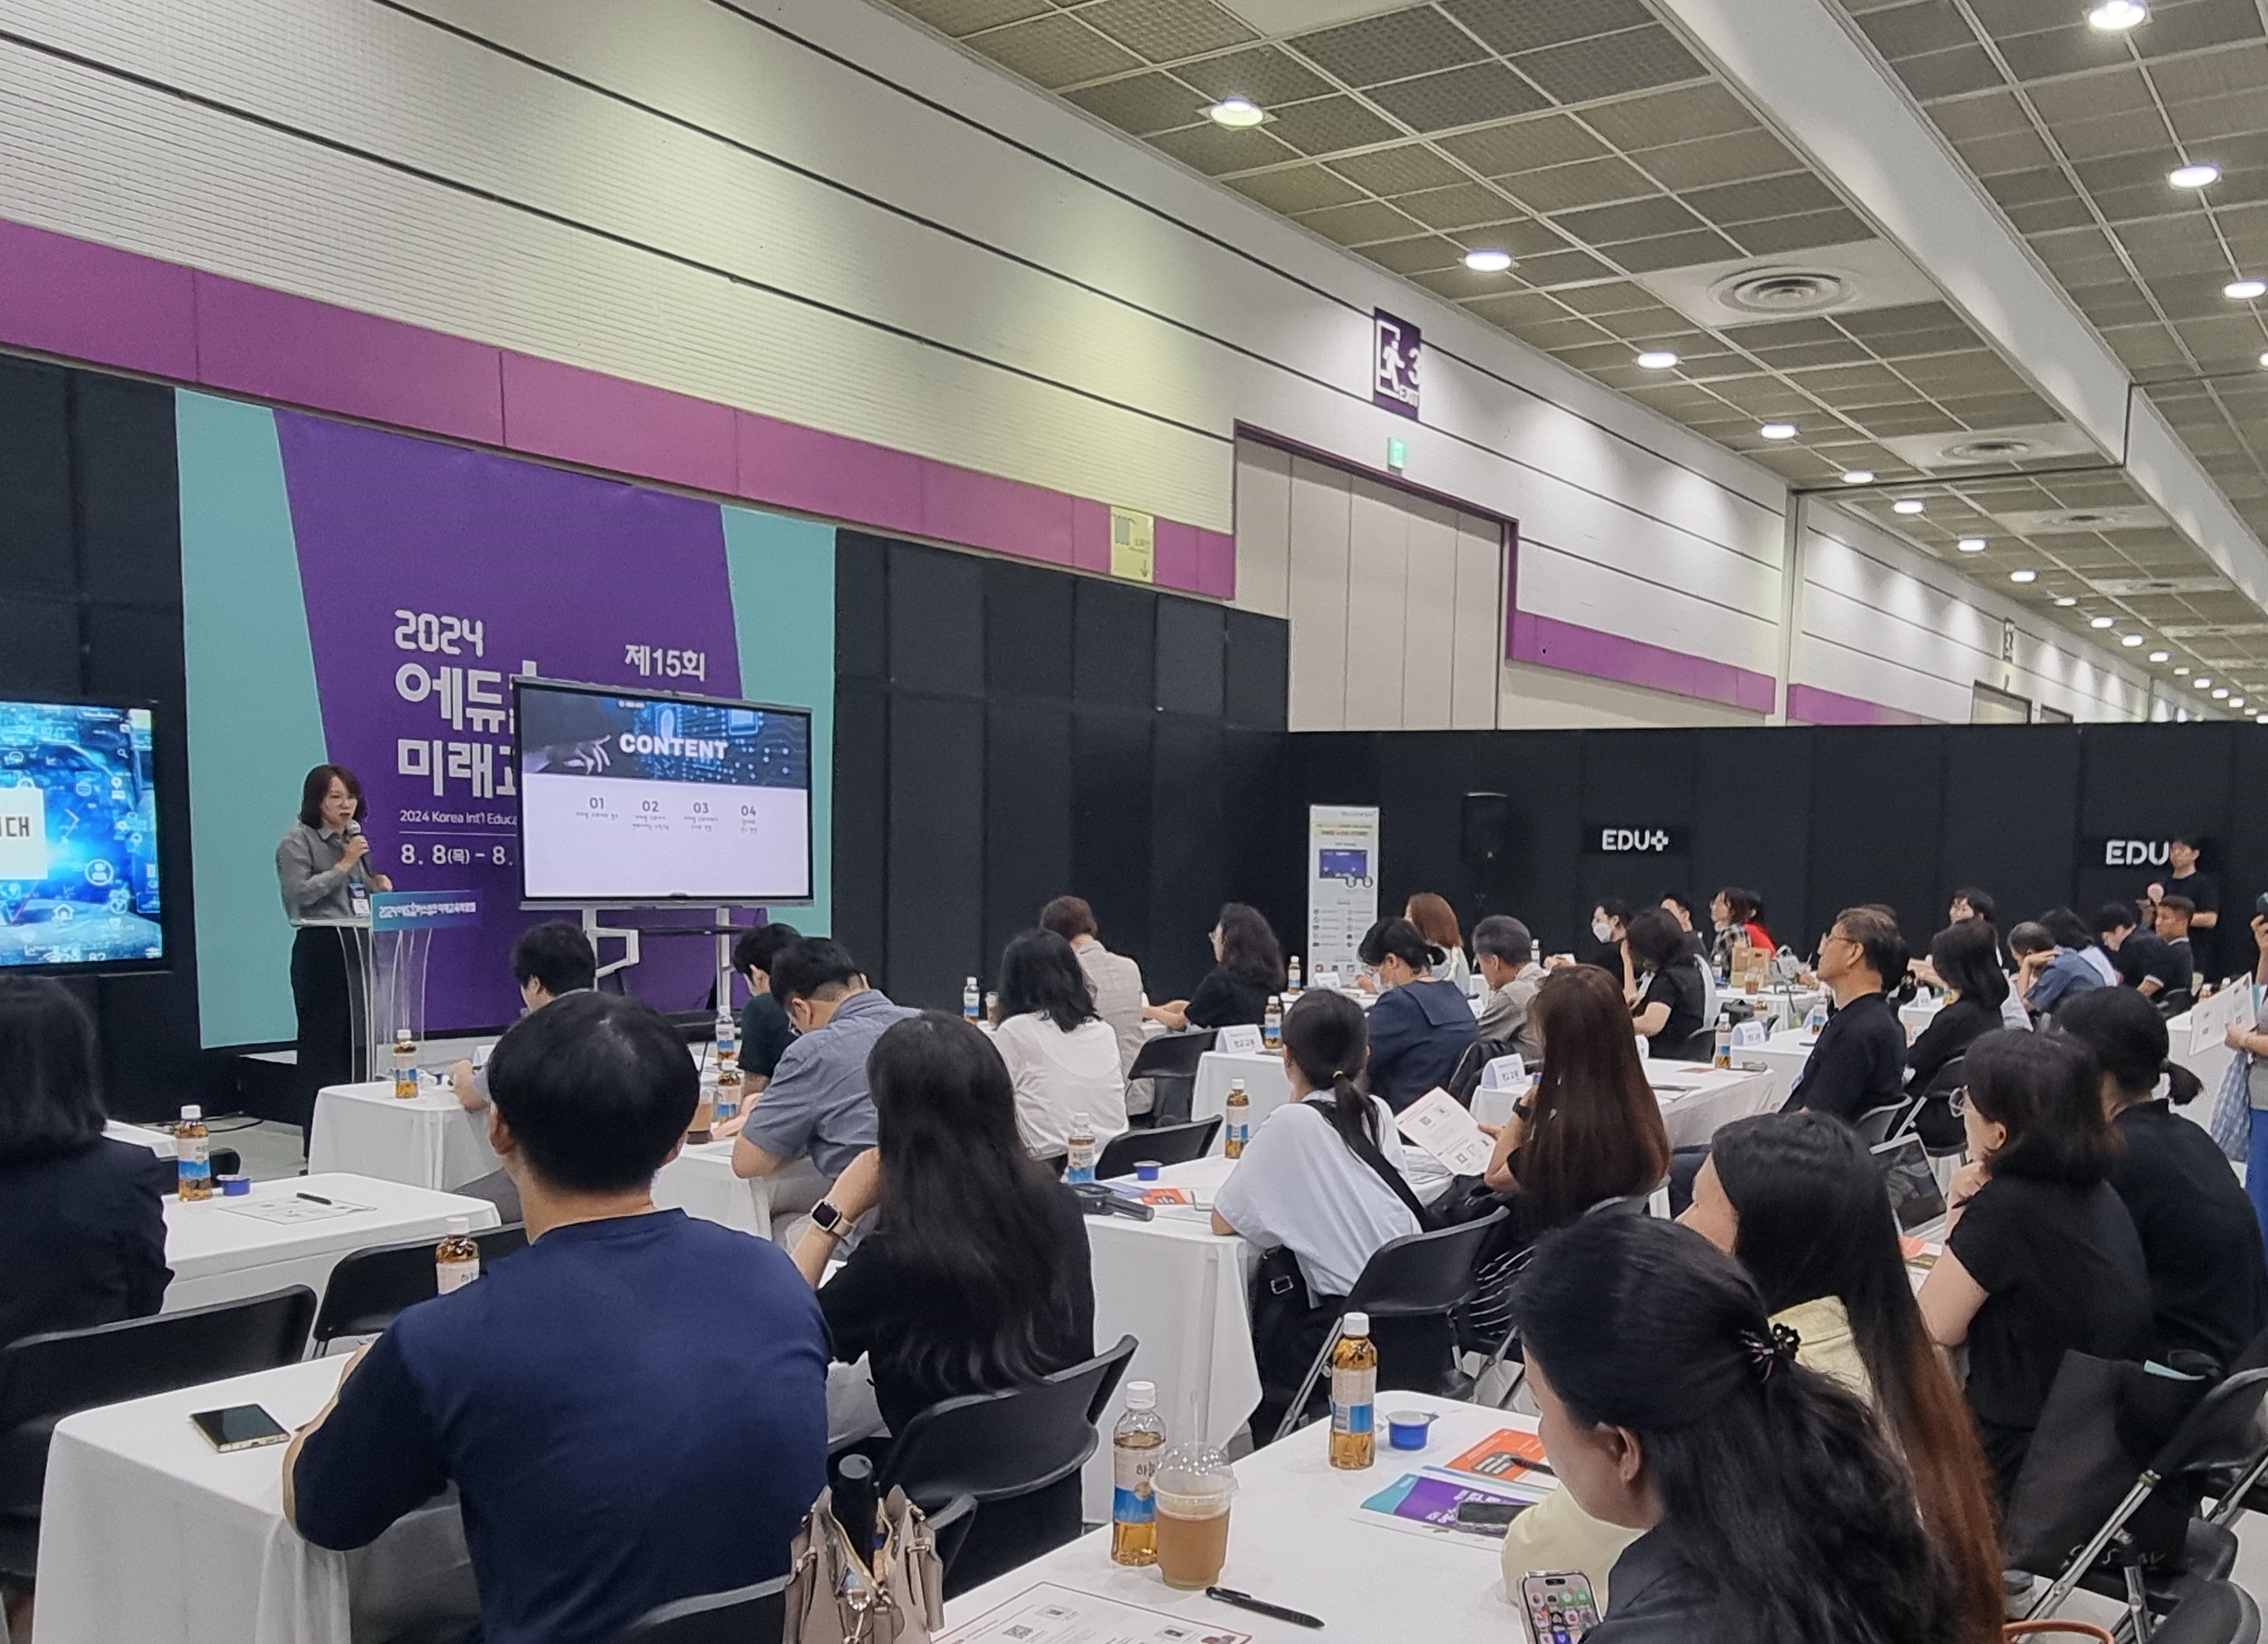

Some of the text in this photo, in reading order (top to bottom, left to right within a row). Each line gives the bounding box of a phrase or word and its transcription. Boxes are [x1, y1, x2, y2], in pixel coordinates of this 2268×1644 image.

[394, 610, 484, 658] 2024
[625, 644, 705, 682] 제15회
[395, 660, 536, 733] 에듀
[619, 733, 728, 760] CONTENT
[589, 797, 604, 810] 01
[642, 800, 659, 813] 02
[693, 802, 709, 814] 03
[741, 805, 756, 817] 04
[400, 810, 429, 822] 2024
[432, 811, 464, 823] Korea
[0, 816, 31, 837] CH
